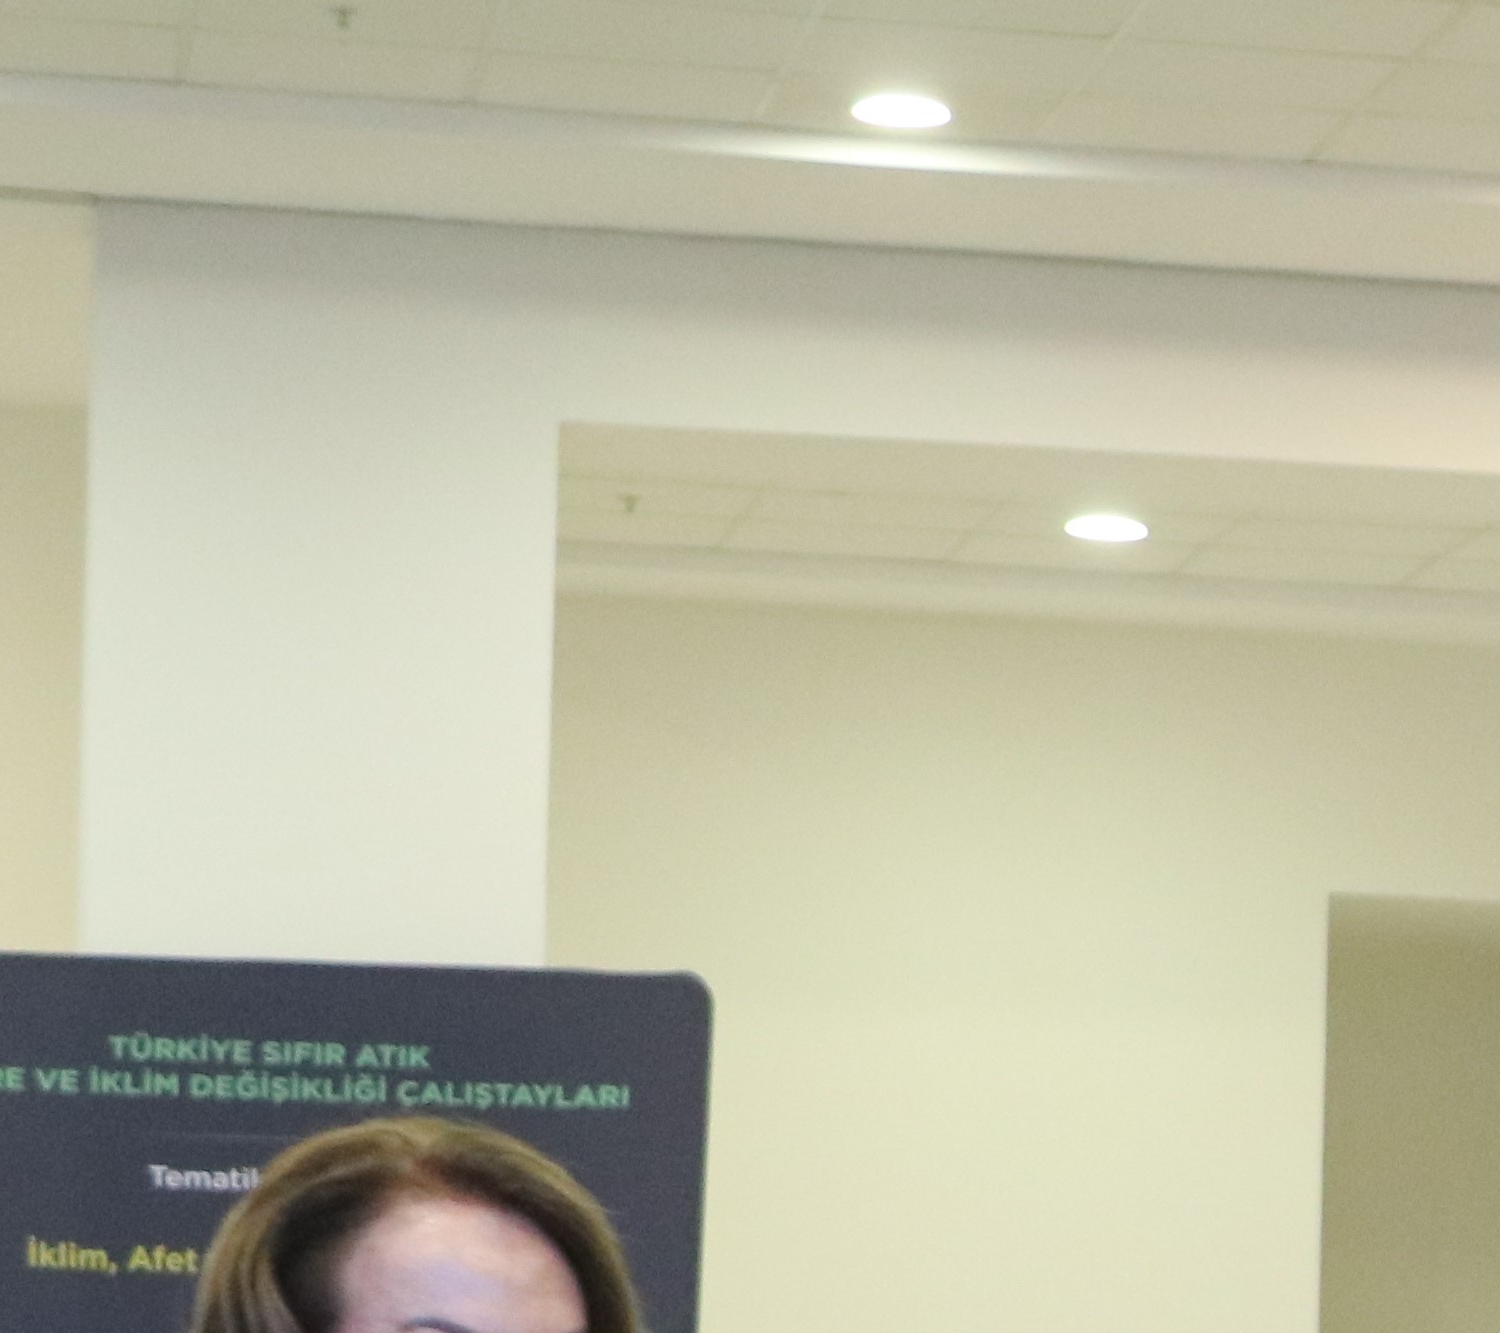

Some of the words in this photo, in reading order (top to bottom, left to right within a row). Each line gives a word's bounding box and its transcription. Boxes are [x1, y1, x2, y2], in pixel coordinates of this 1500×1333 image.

[108, 1031, 253, 1062] TÜRKİYE
[262, 1040, 346, 1066] SIFIR
[355, 1044, 431, 1069] ATIK
[33, 1067, 79, 1094] VE
[88, 1065, 179, 1096] İKLİM
[188, 1069, 387, 1105] DEĞİŞİKLİĞİ
[397, 1078, 630, 1110] ÇALIŞTAYLARI
[26, 1234, 118, 1276] İklim,
[127, 1244, 200, 1275] Afet
